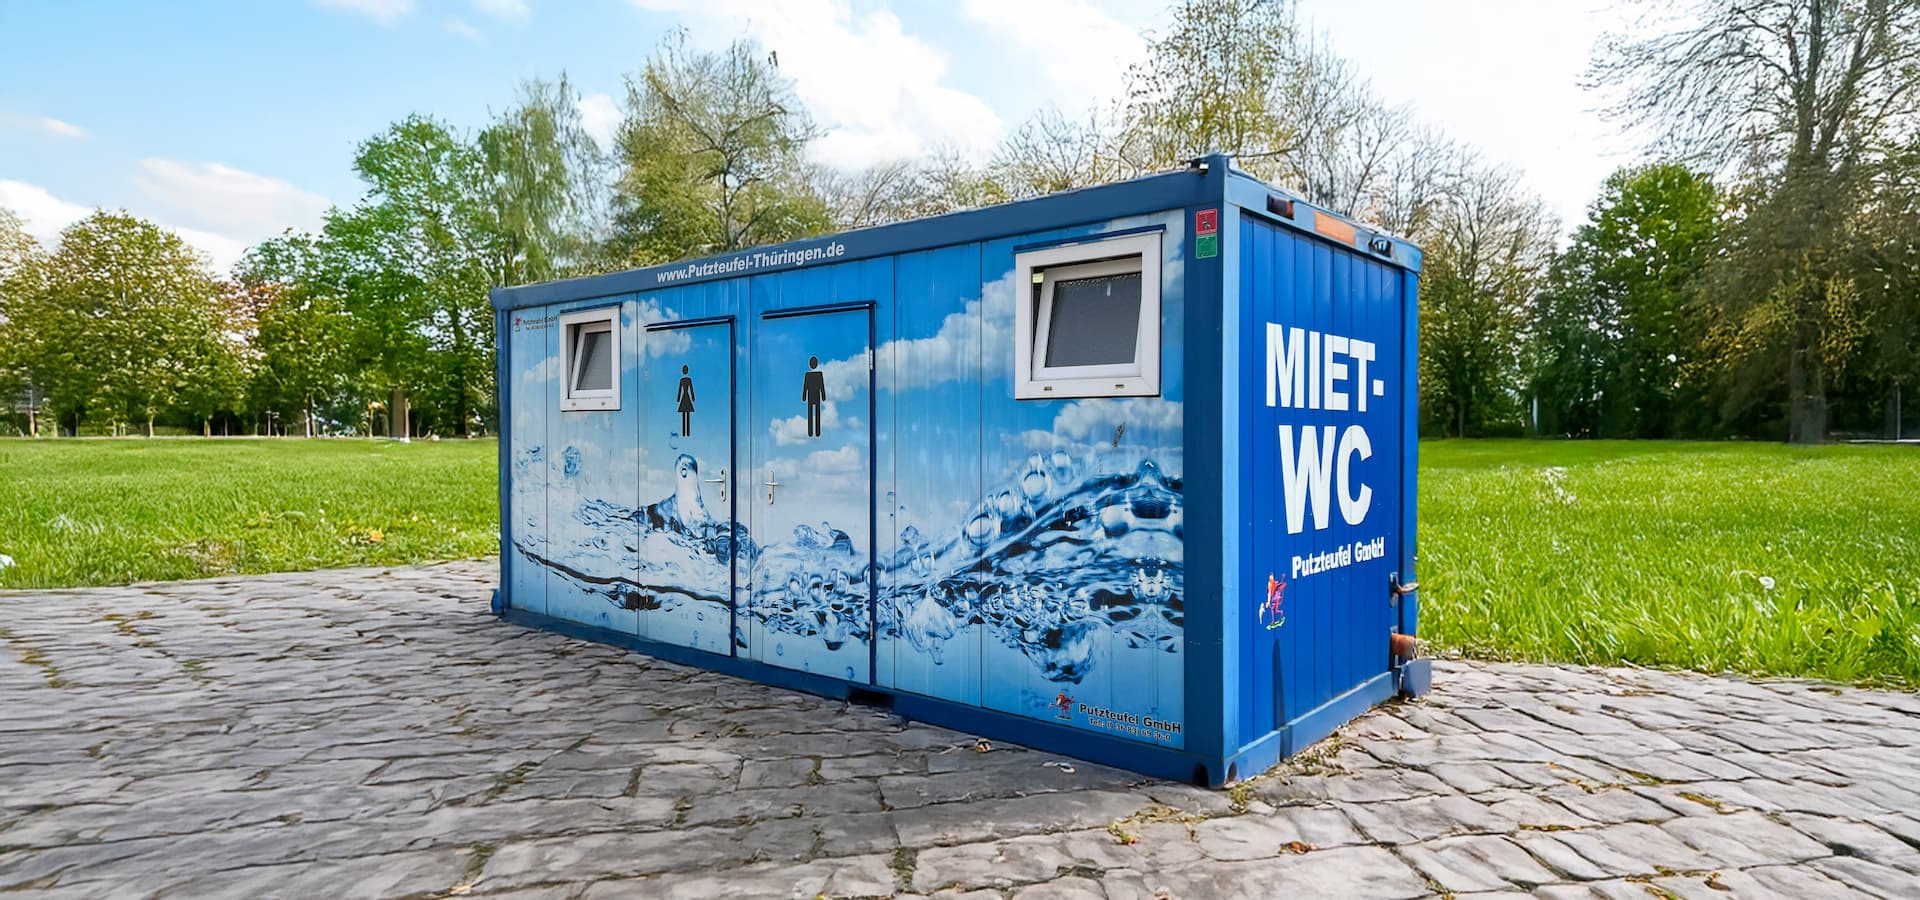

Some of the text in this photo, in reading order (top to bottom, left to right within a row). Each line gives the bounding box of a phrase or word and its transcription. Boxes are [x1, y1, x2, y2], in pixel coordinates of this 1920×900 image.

[656, 241, 845, 283] www.Putzteufel-Thüringen.de
[1265, 321, 1385, 412] MIET-
[1278, 424, 1373, 535] WC
[1291, 536, 1385, 579] Putzteufel GmbH
[1080, 703, 1181, 733] Putzteufel GmbH
